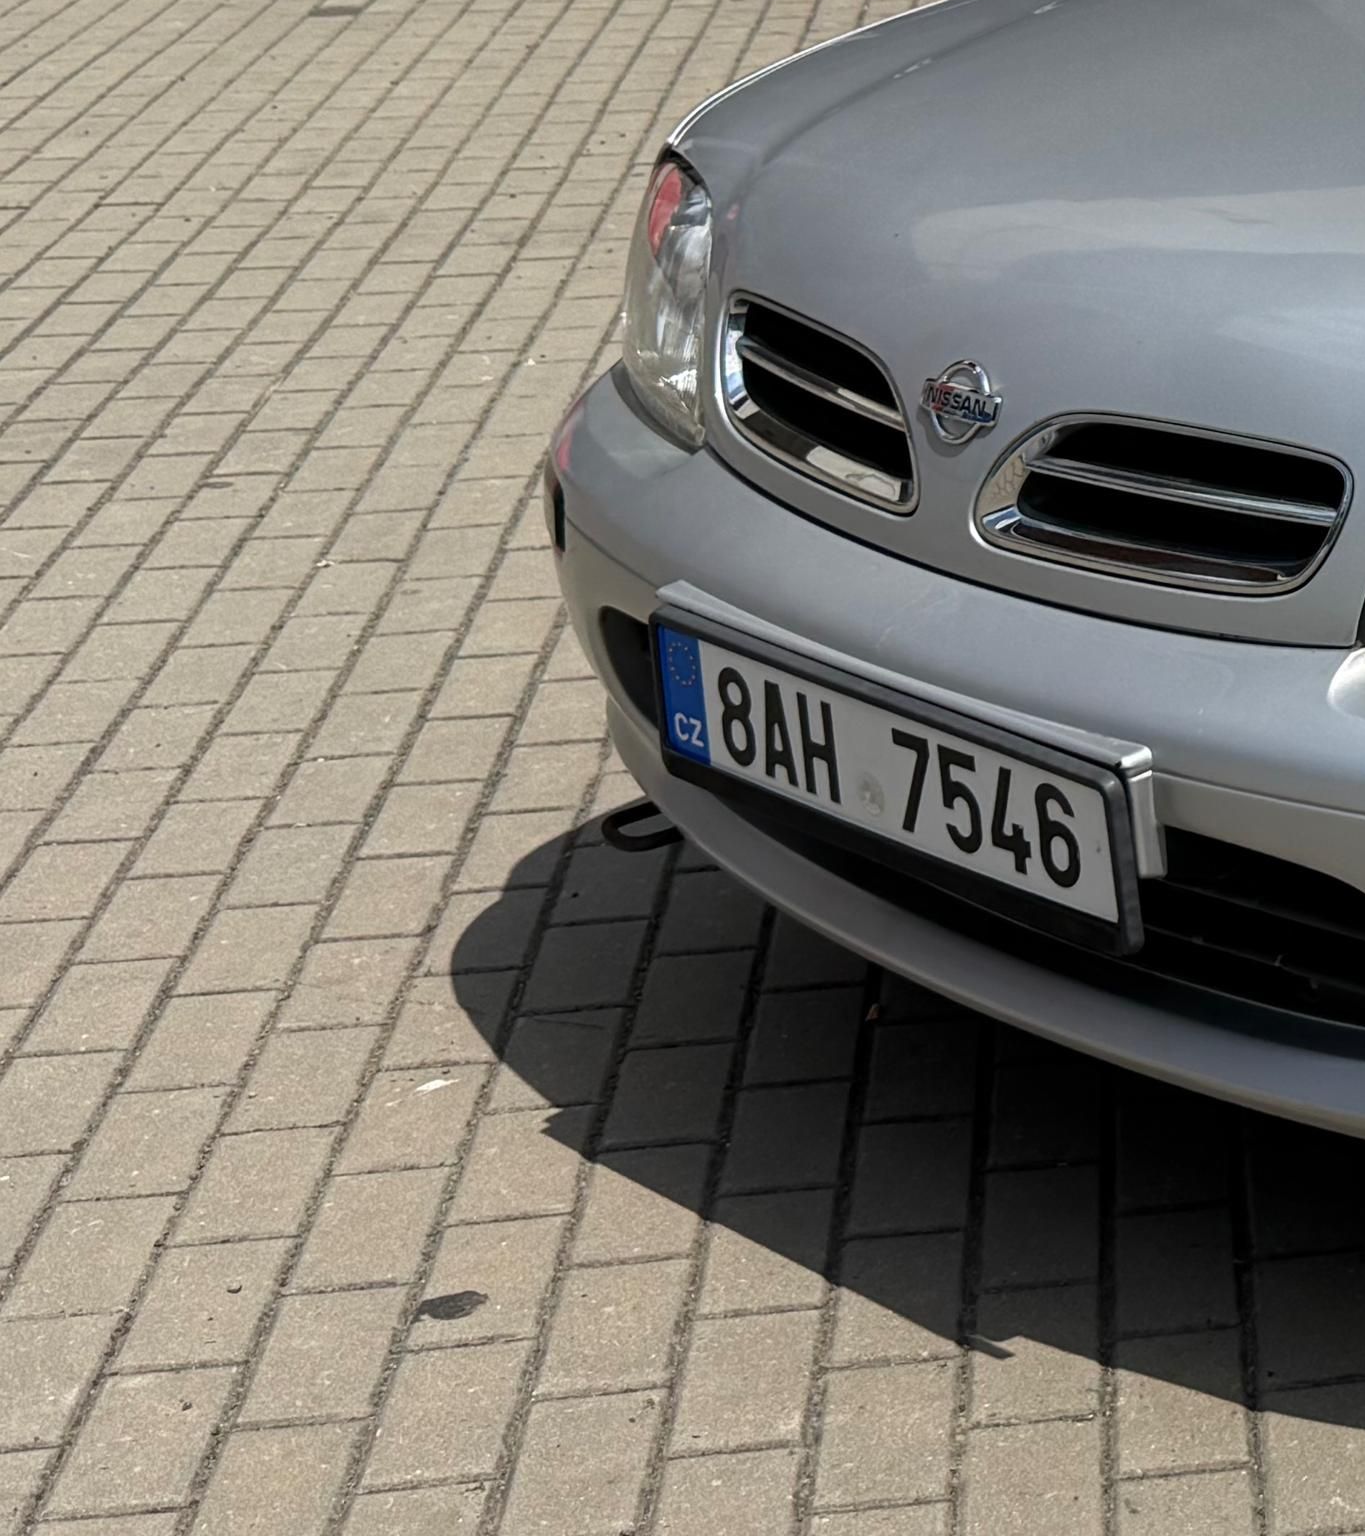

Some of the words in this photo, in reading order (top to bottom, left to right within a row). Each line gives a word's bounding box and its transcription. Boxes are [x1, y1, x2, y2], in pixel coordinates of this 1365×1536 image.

[926, 385, 987, 417] NISSAN
[673, 712, 705, 748] CZ
[717, 666, 842, 805] 8AH
[890, 726, 1081, 889] 7546
